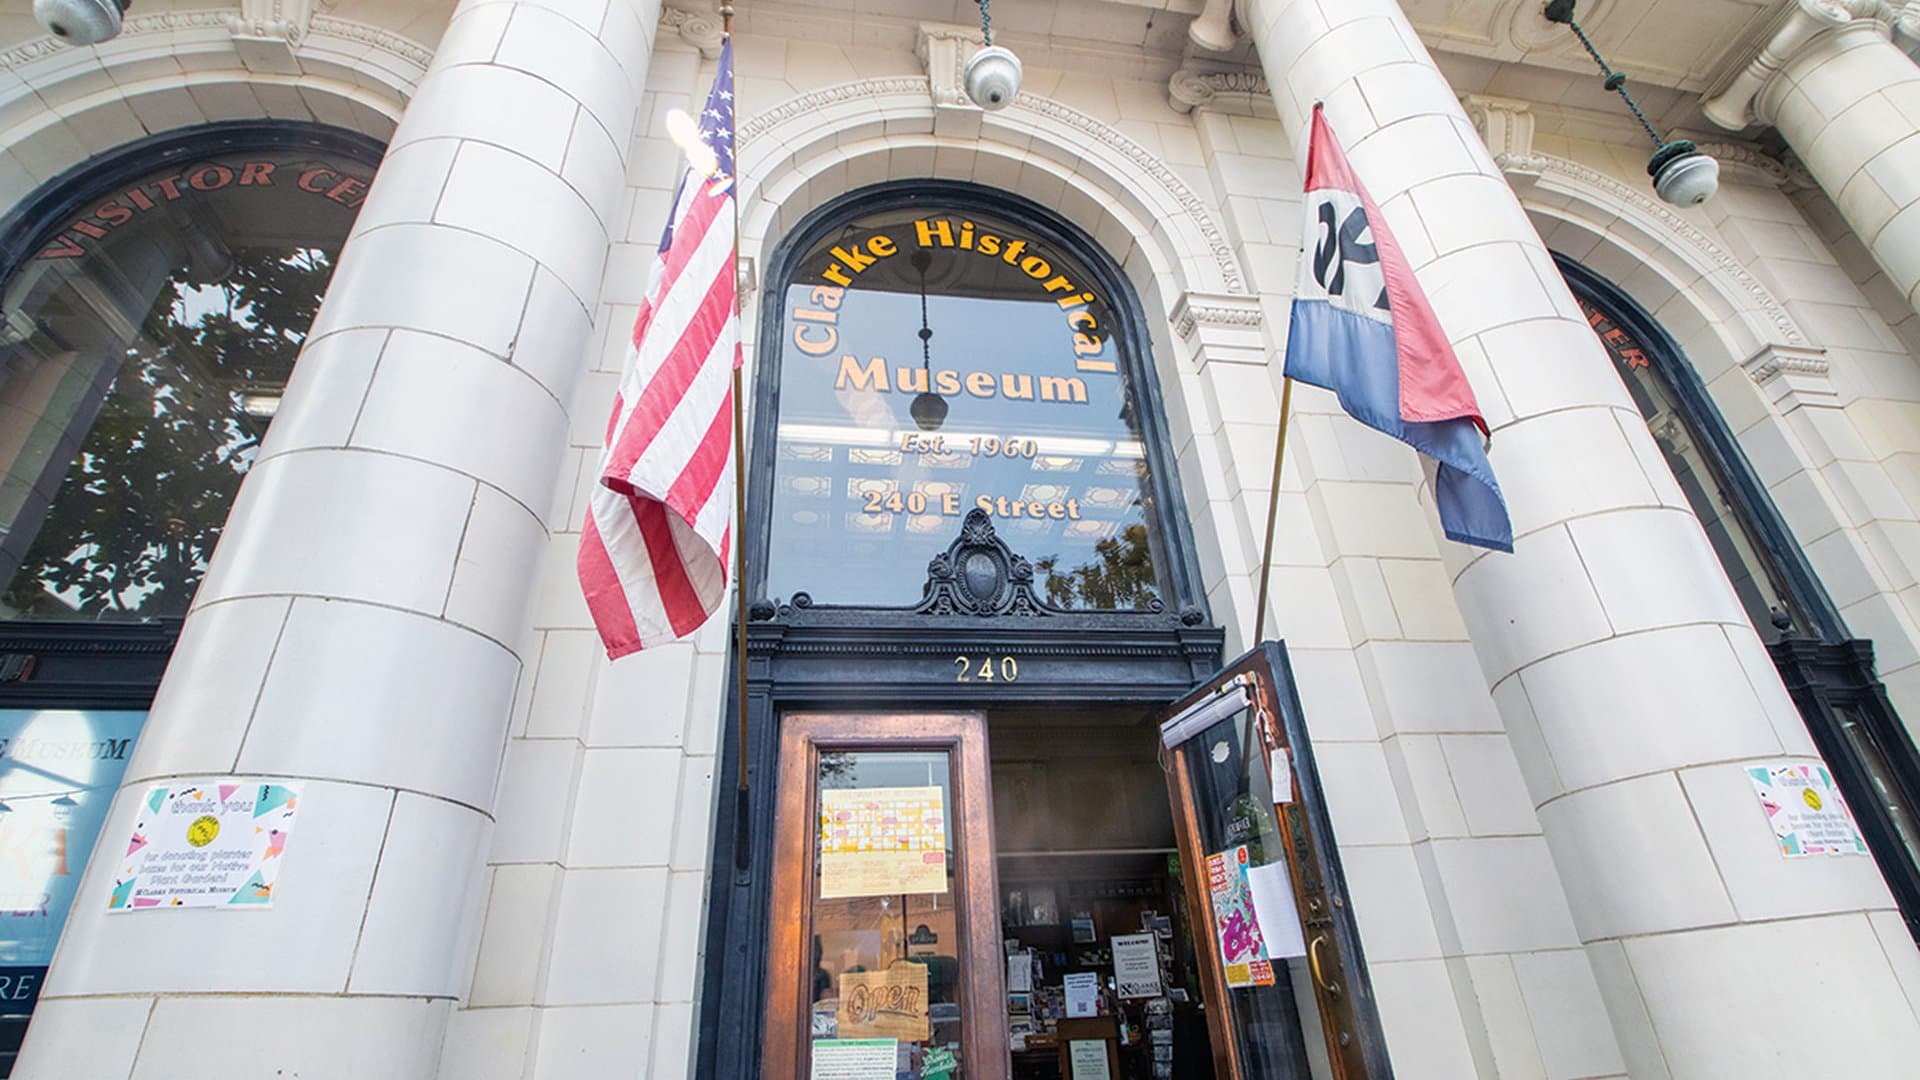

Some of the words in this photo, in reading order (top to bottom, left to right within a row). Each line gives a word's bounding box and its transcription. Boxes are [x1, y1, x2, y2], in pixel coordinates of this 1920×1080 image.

[39, 161, 278, 261] VISITOR
[792, 233, 898, 356] Clarke
[914, 219, 1118, 374] Historical
[1577, 299, 1650, 370] TER
[834, 355, 1089, 404] Museum
[900, 433, 952, 454] Est.
[968, 436, 1038, 459] 1960
[862, 490, 926, 515] 240
[941, 492, 961, 516] E
[976, 494, 1082, 520] Street
[954, 656, 1018, 682] 240
[220, 800, 254, 816] you
[847, 983, 921, 1025] Open
